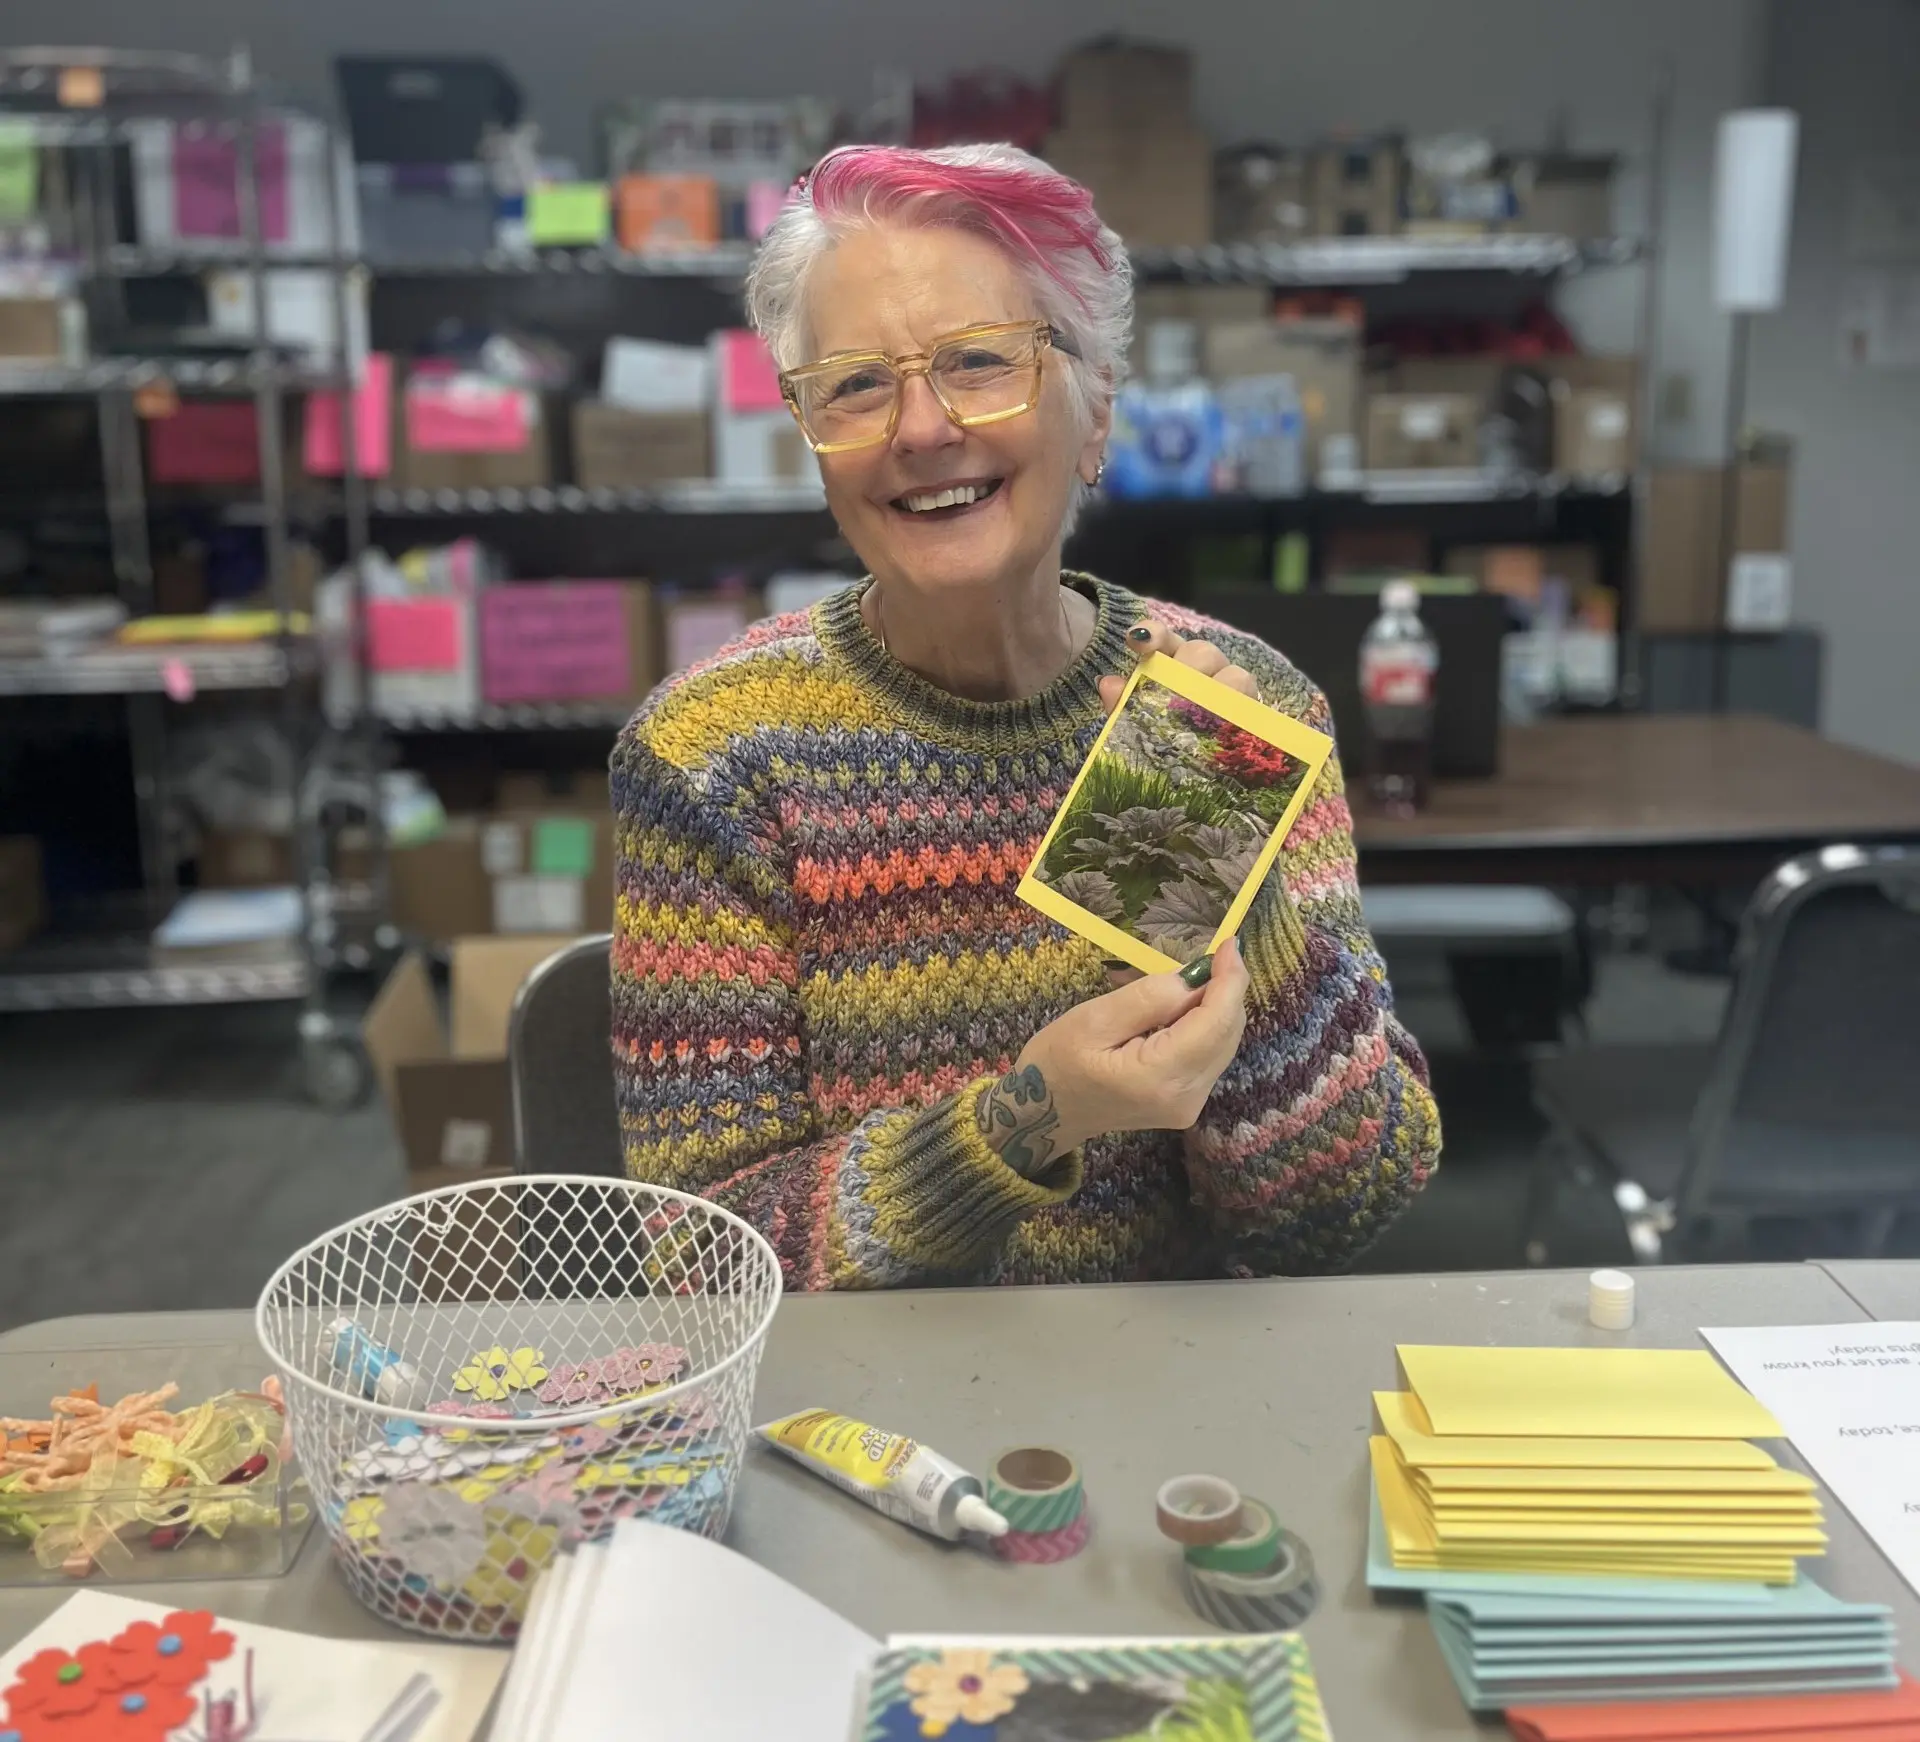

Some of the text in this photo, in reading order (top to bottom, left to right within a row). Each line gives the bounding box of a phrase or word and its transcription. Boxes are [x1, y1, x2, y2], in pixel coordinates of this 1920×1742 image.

[1762, 1357, 1911, 1370] and let you know
[1839, 1426, 1894, 1437] today
[867, 1431, 892, 1462] PID
